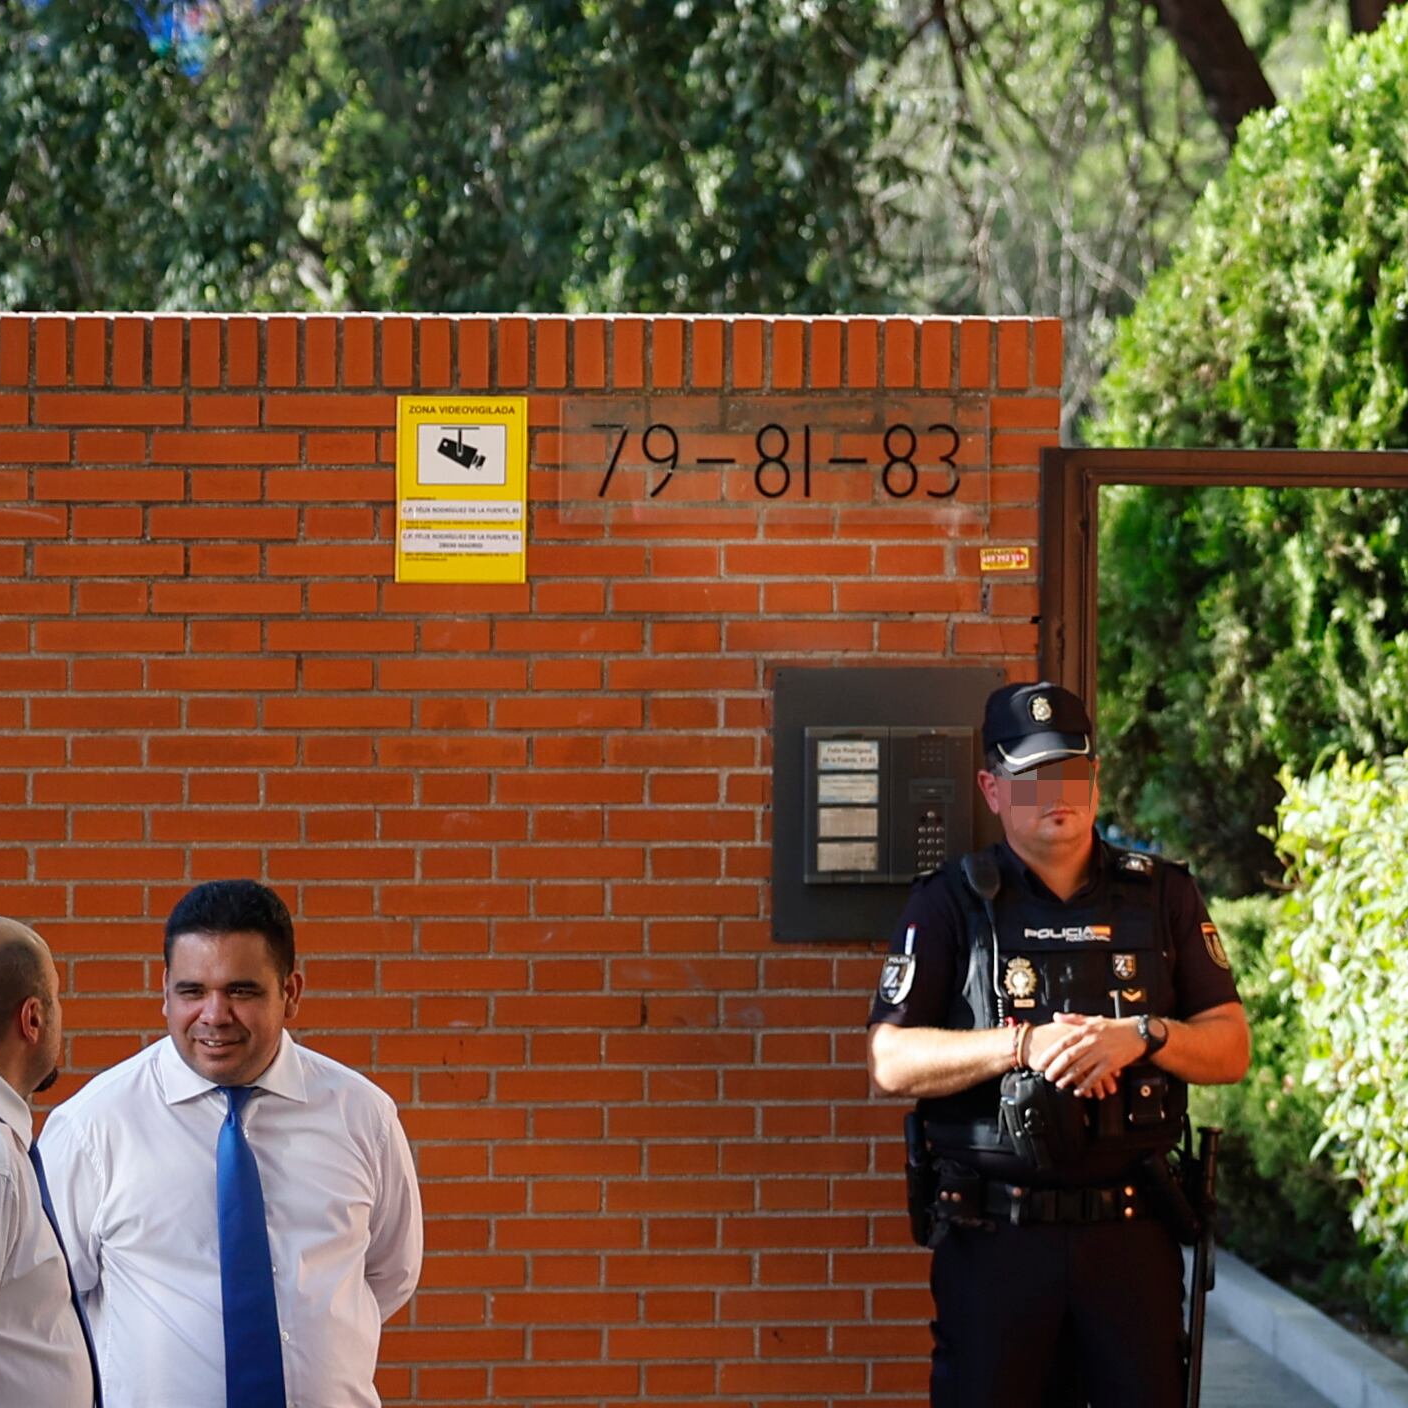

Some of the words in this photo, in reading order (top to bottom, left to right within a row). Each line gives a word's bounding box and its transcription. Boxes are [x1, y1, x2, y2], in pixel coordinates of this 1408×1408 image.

[409, 405, 436, 414] ZONA
[439, 405, 515, 415] VIDEOVIGILADA
[591, 424, 960, 498] 79-81-83
[1024, 926, 1094, 939] POLICIA
